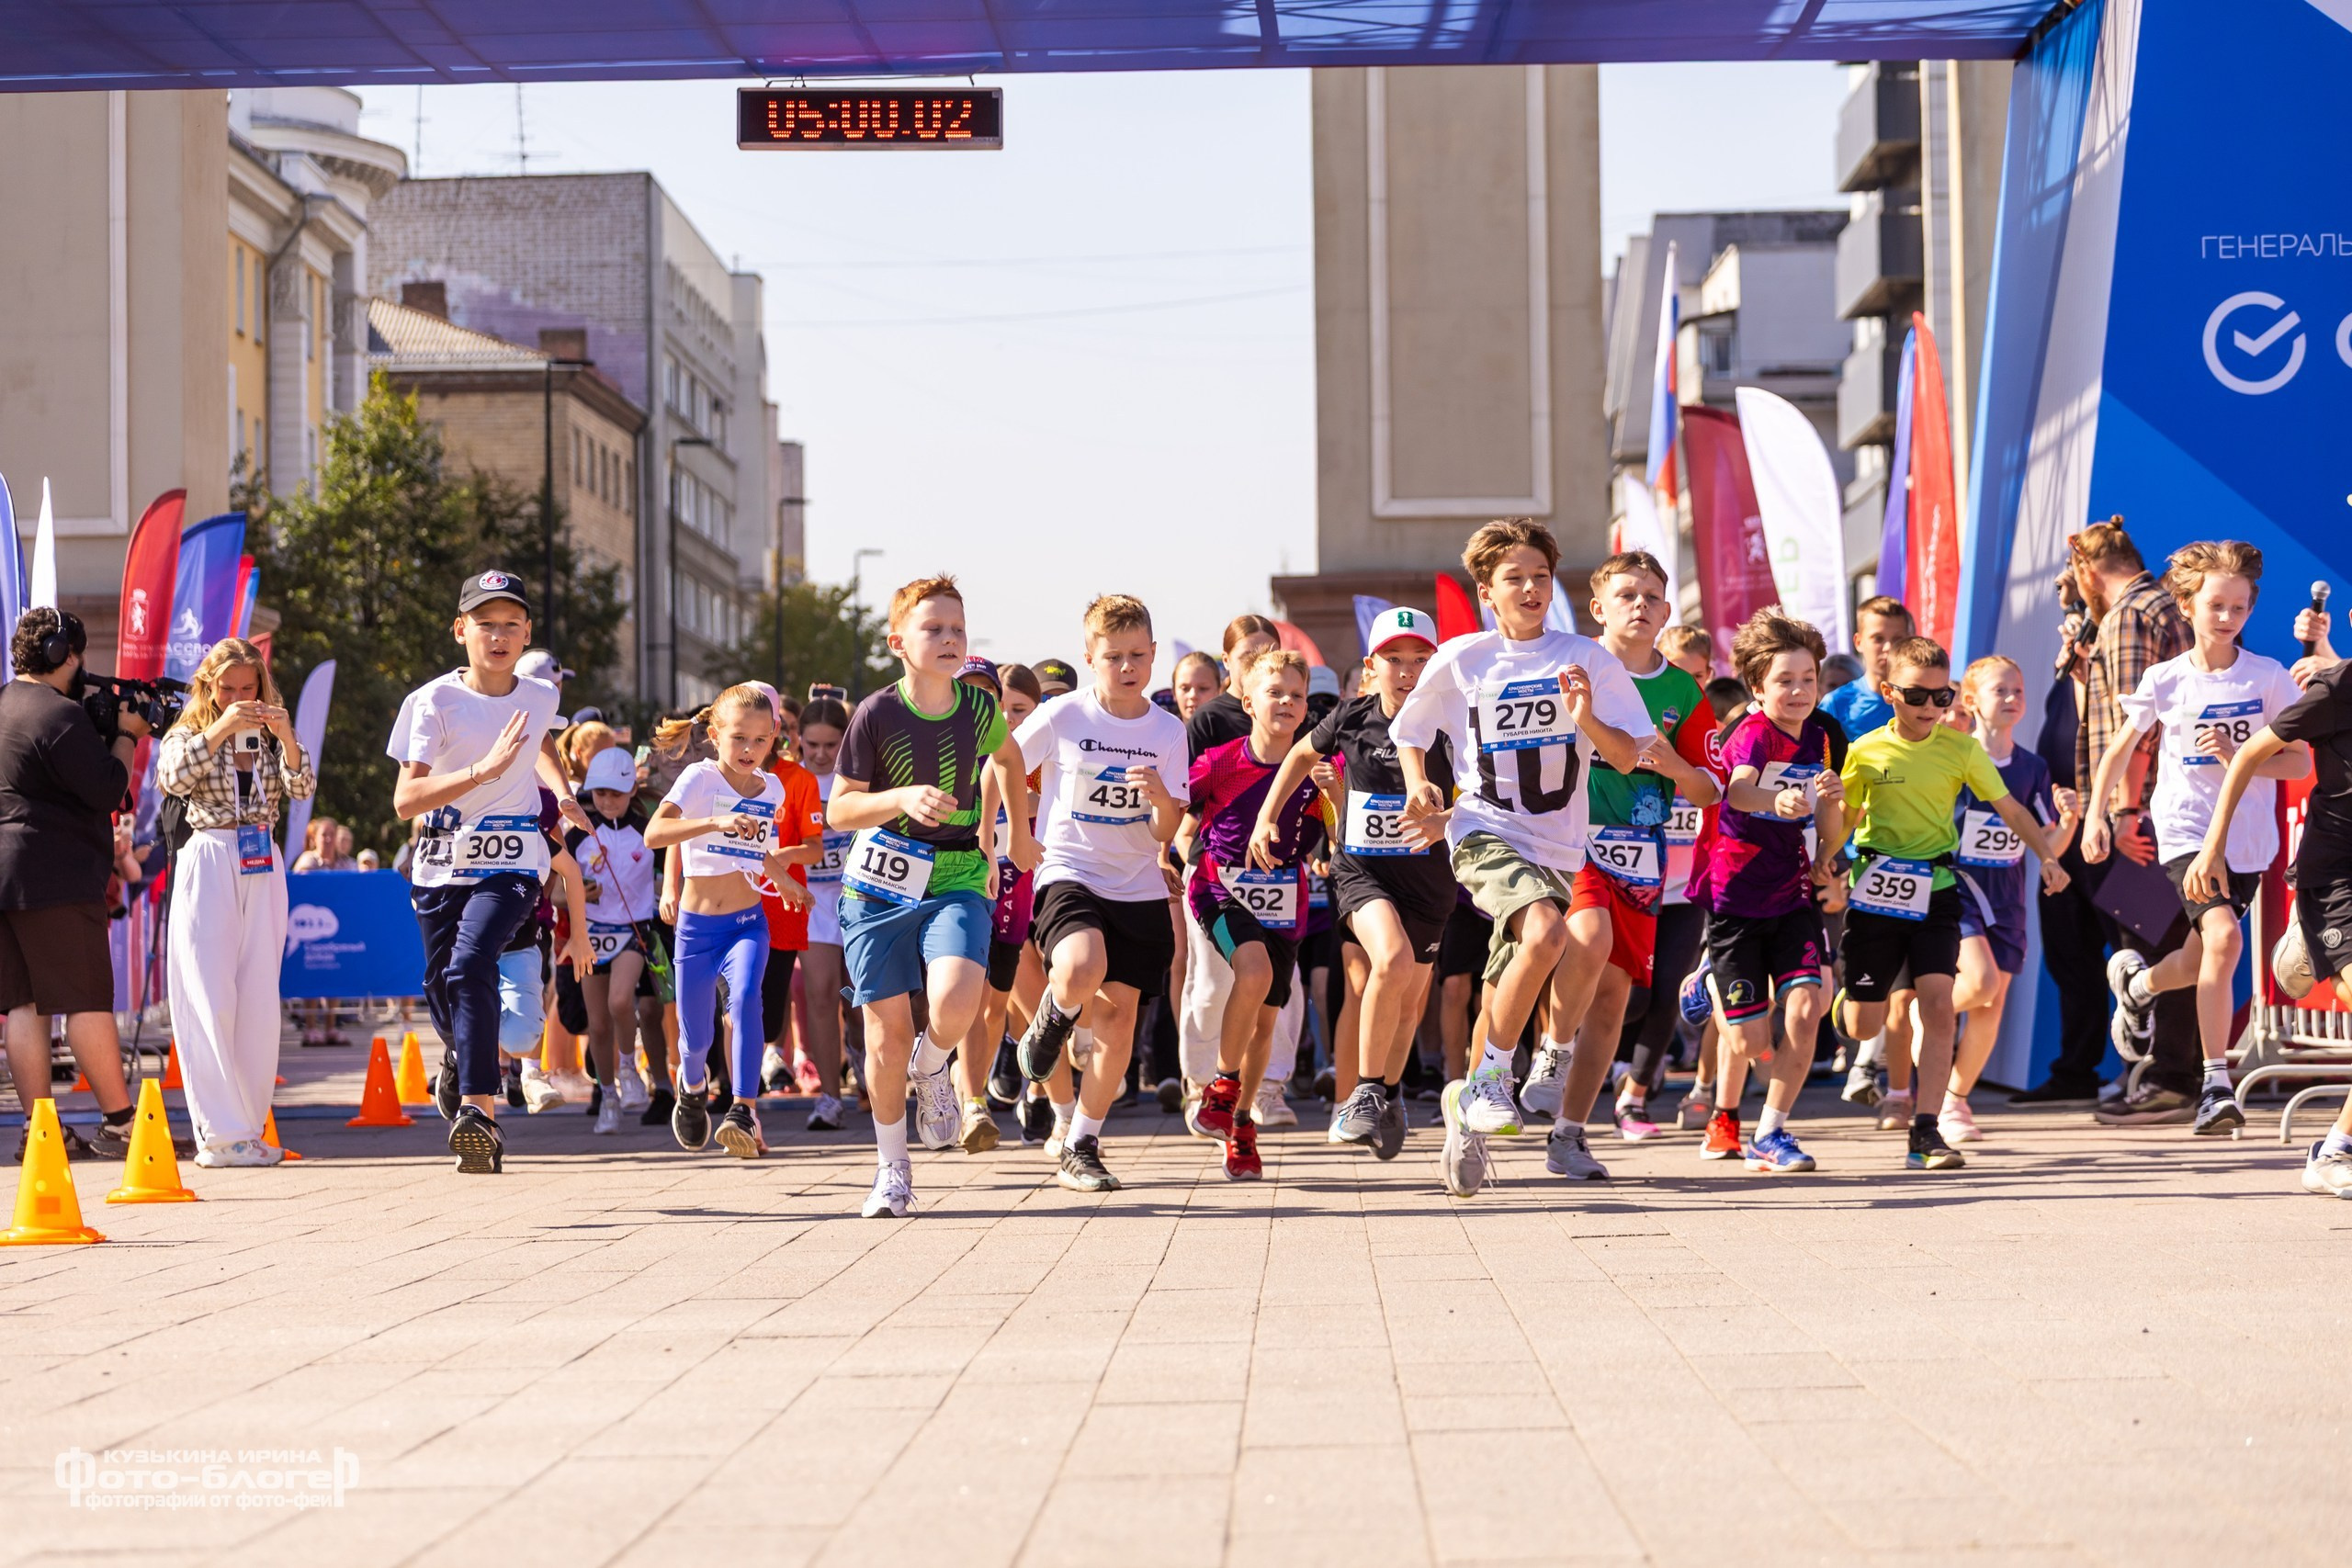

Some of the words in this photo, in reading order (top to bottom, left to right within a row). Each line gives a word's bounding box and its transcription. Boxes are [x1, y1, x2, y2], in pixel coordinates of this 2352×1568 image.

[1495, 699, 1557, 731] 279
[1502, 729, 1529, 738] ГУБАРЕВ
[1529, 727, 1554, 736] НИКИТА
[1079, 738, 1158, 761] Champion
[1088, 784, 1141, 809] 431
[1364, 814, 1404, 839] 83
[466, 834, 524, 860] 309
[1973, 829, 2021, 852] 299
[809, 851, 842, 870] 13
[860, 846, 910, 882] 119
[1594, 843, 1643, 869] 267
[882, 879, 907, 892] МАКСИМ
[1865, 872, 1917, 901] 359
[1232, 886, 1283, 911] 262
